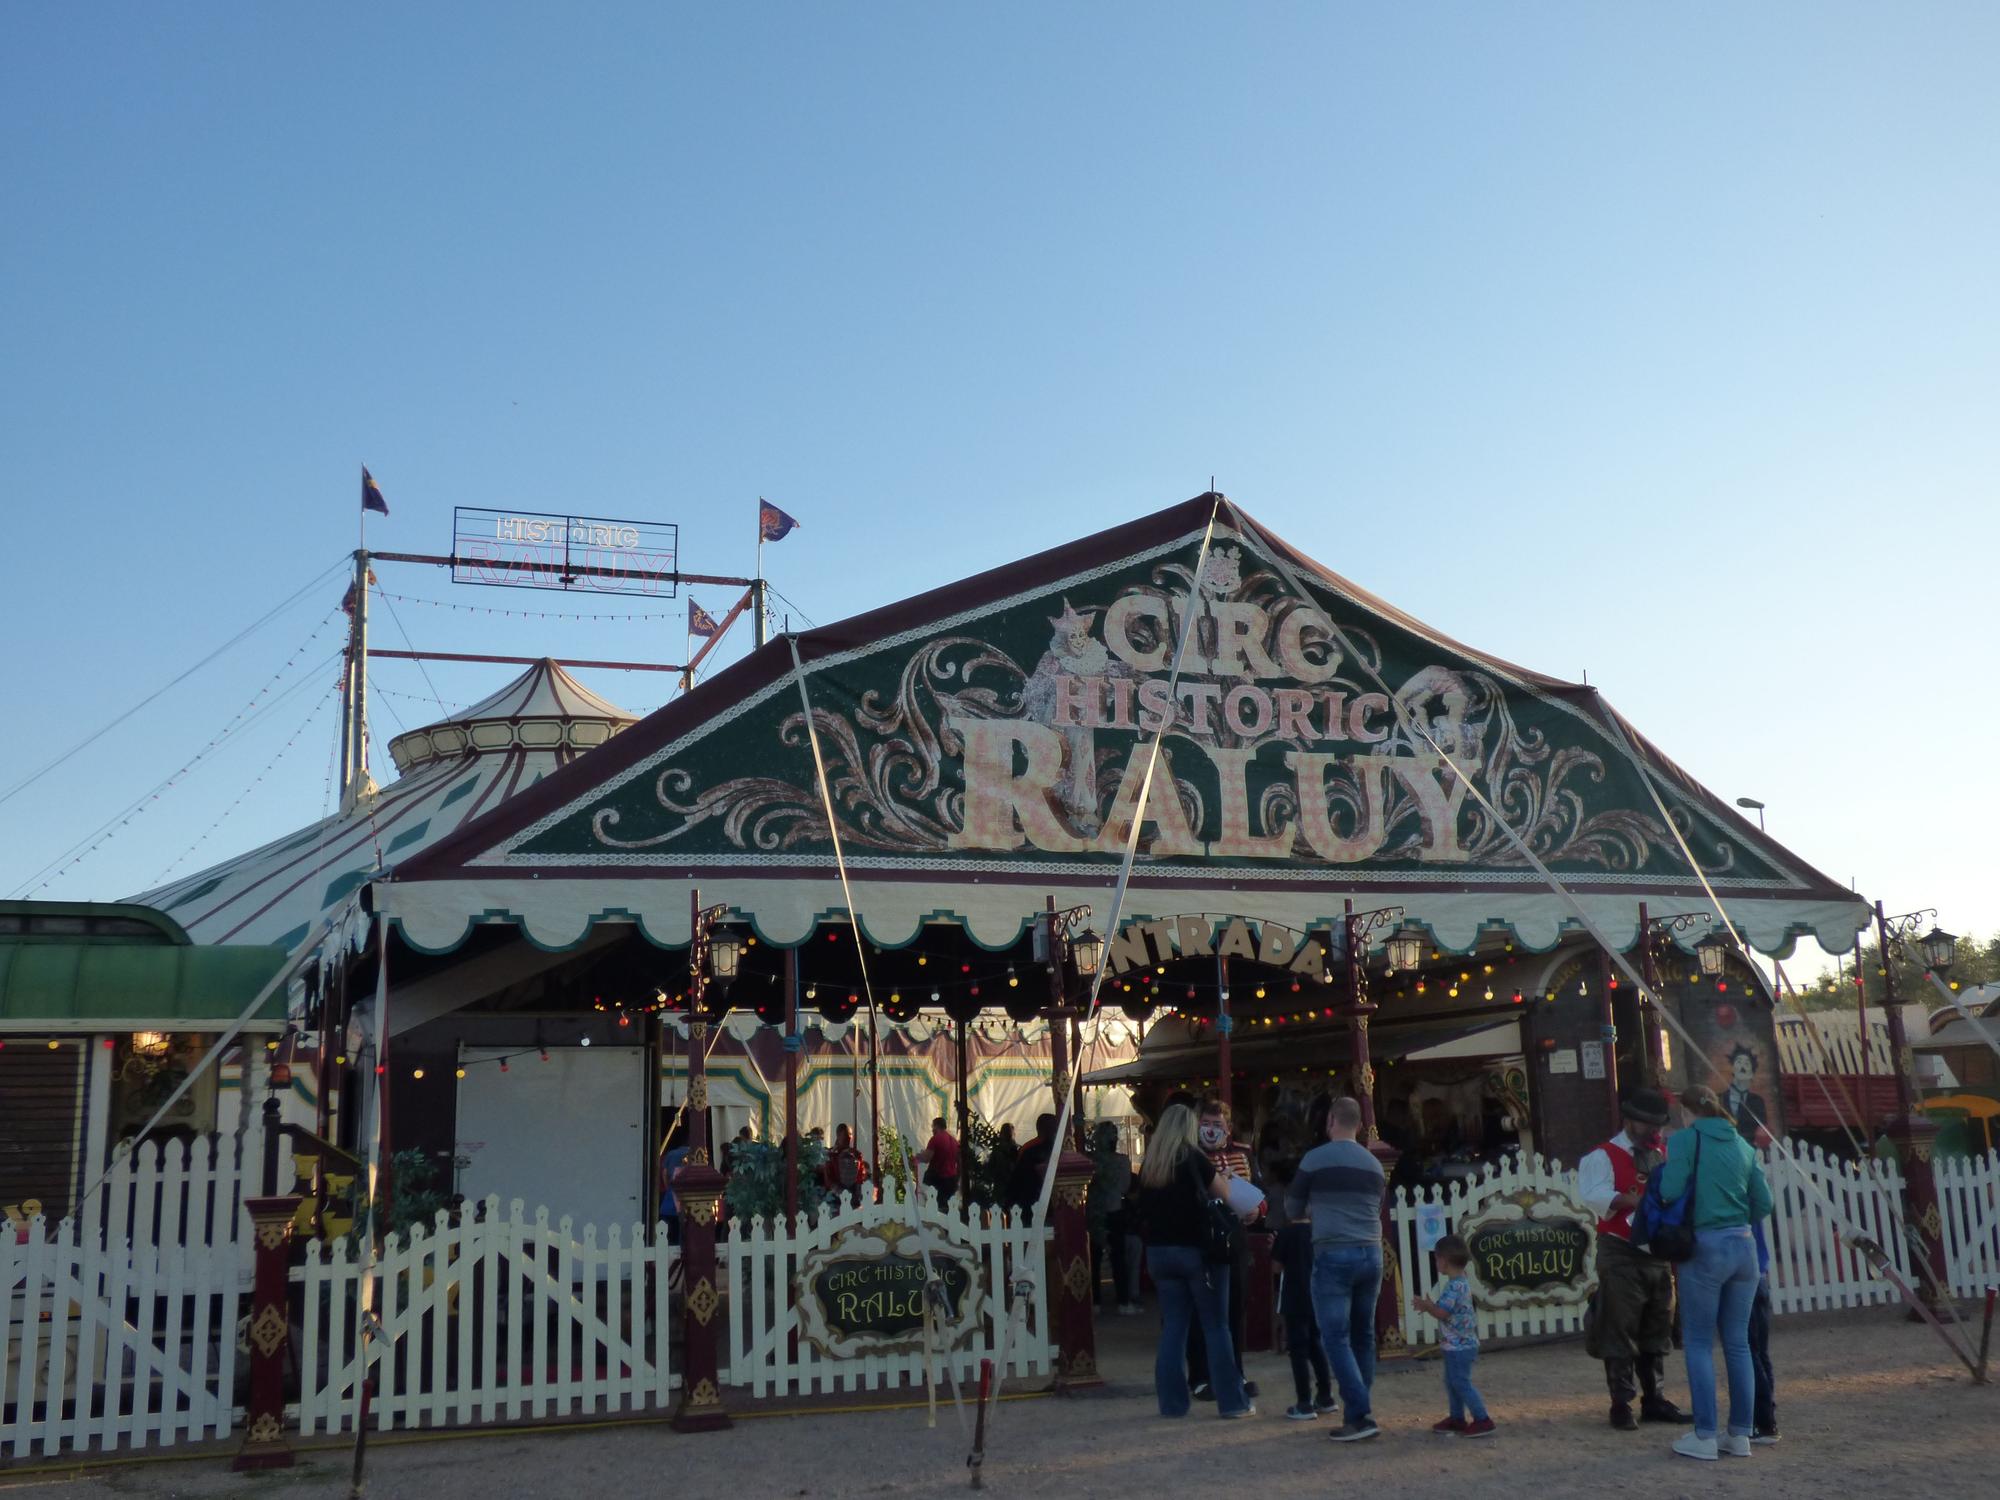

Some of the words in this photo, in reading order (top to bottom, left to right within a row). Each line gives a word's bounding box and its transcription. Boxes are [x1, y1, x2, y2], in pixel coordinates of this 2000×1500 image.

[454, 538, 674, 594] RALUY
[1102, 592, 1345, 683] CIRC
[947, 716, 1482, 864] RALUY
[1101, 916, 1325, 985] NTRADA
[1478, 1231, 1512, 1253] CIRC
[1486, 1248, 1575, 1281] RALUY
[828, 1265, 871, 1291] CIRC
[837, 1290, 926, 1324] RALU
